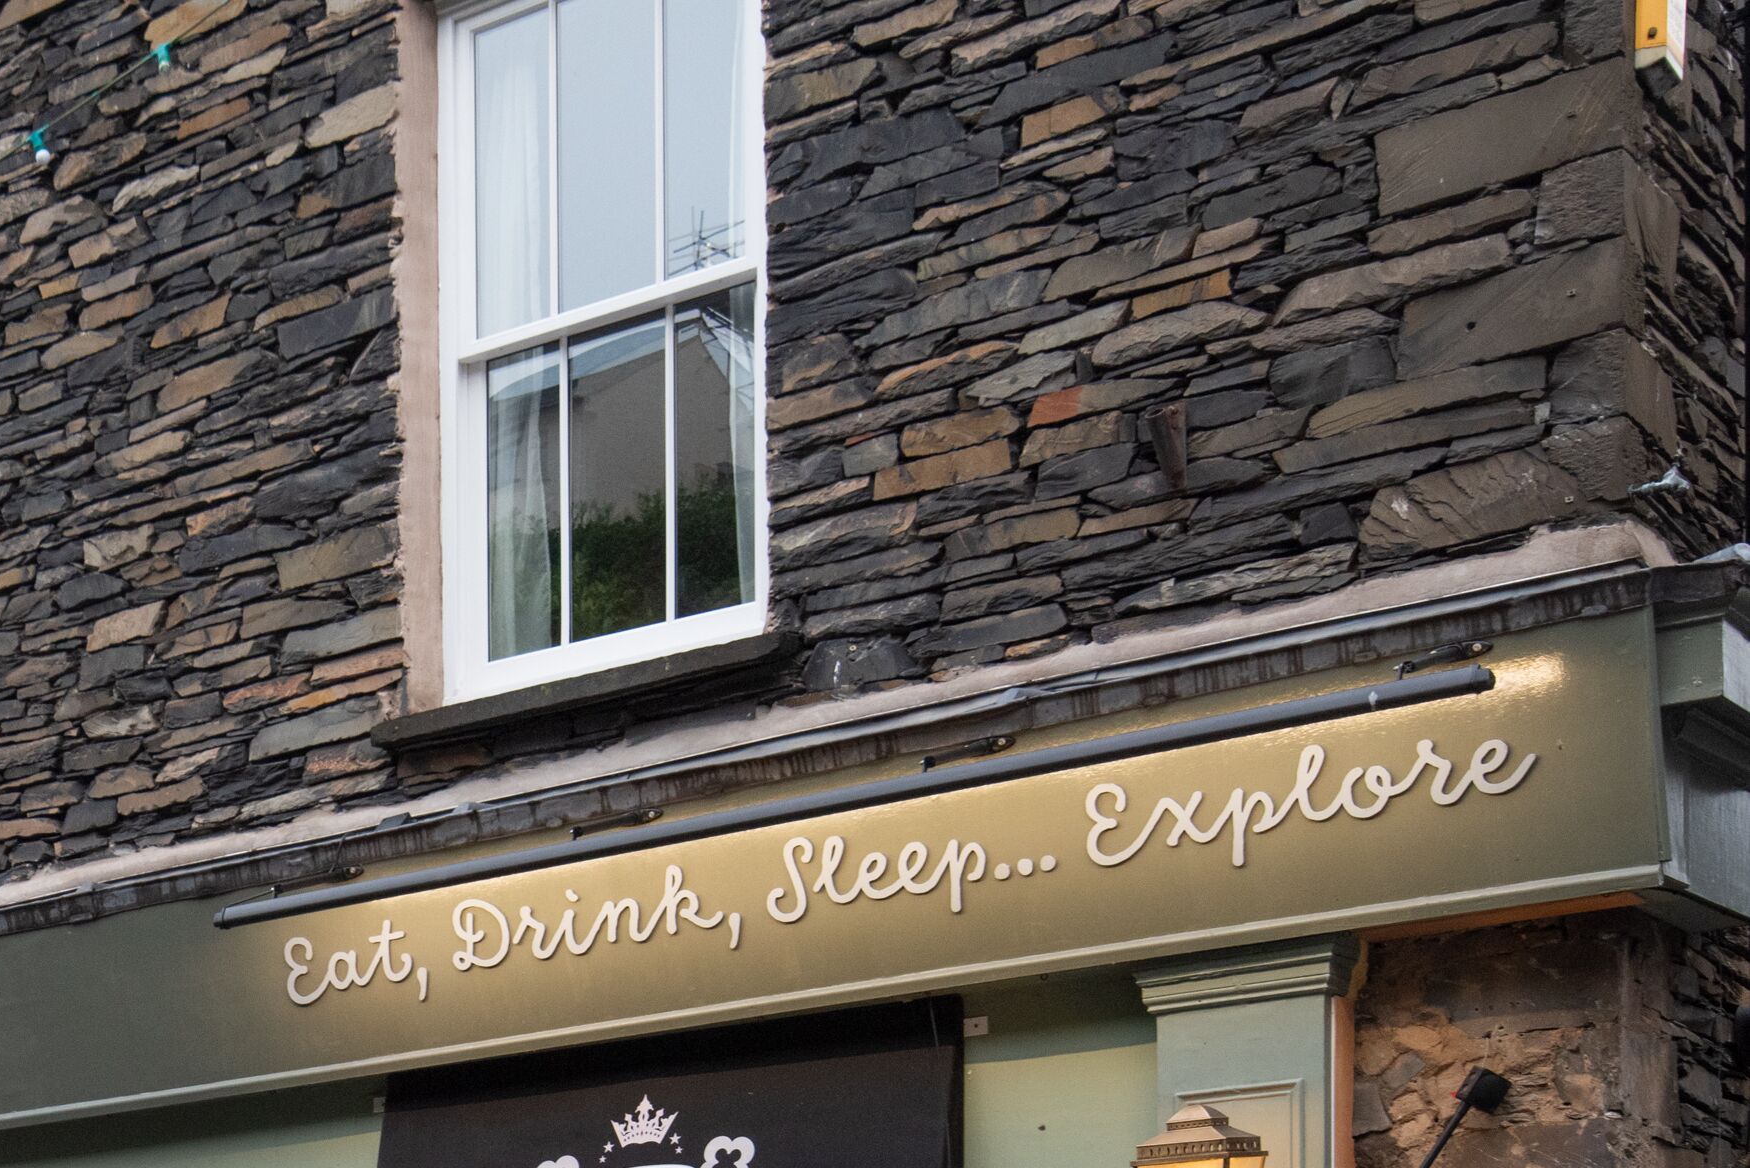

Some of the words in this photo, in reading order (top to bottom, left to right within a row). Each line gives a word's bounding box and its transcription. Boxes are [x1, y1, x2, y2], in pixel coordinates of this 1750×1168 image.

[283, 919, 429, 1005] Eat,
[452, 864, 742, 971] Drink,
[766, 834, 1057, 923] Sleep...
[1084, 738, 1538, 867] Explore
